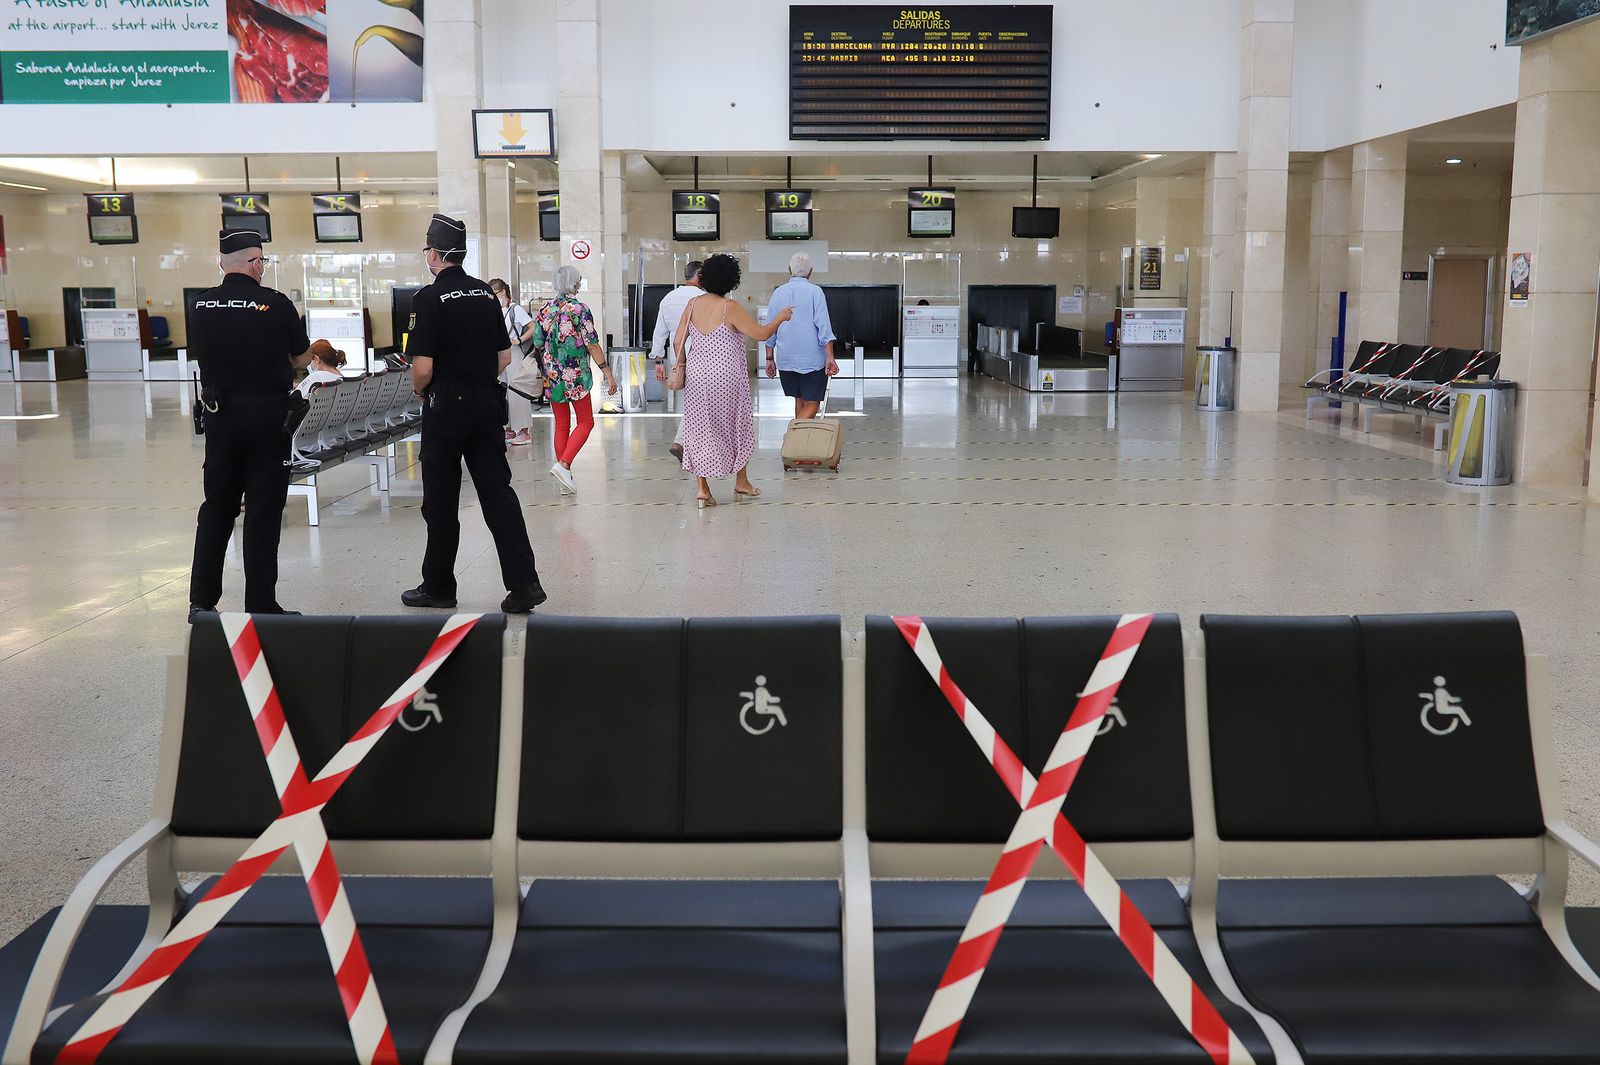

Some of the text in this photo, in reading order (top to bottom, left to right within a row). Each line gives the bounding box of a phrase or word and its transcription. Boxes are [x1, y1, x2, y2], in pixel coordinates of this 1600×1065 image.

[900, 10, 941, 20] SALIDAS
[8, 13, 219, 35] at the airport... start with Jerez
[892, 19, 951, 30] DEPARTURES
[15, 61, 216, 77] Saborea Andalucía en el aeropuerto...
[64, 71, 162, 90] empieza por Jerez
[100, 197, 121, 212] 13
[234, 197, 256, 212] 14
[327, 196, 347, 211] 15
[552, 195, 559, 209] 1
[687, 195, 707, 209] 18
[778, 194, 799, 209] 19
[920, 192, 942, 207] 20
[1143, 261, 1158, 273] 21
[195, 299, 259, 309] POLICIA
